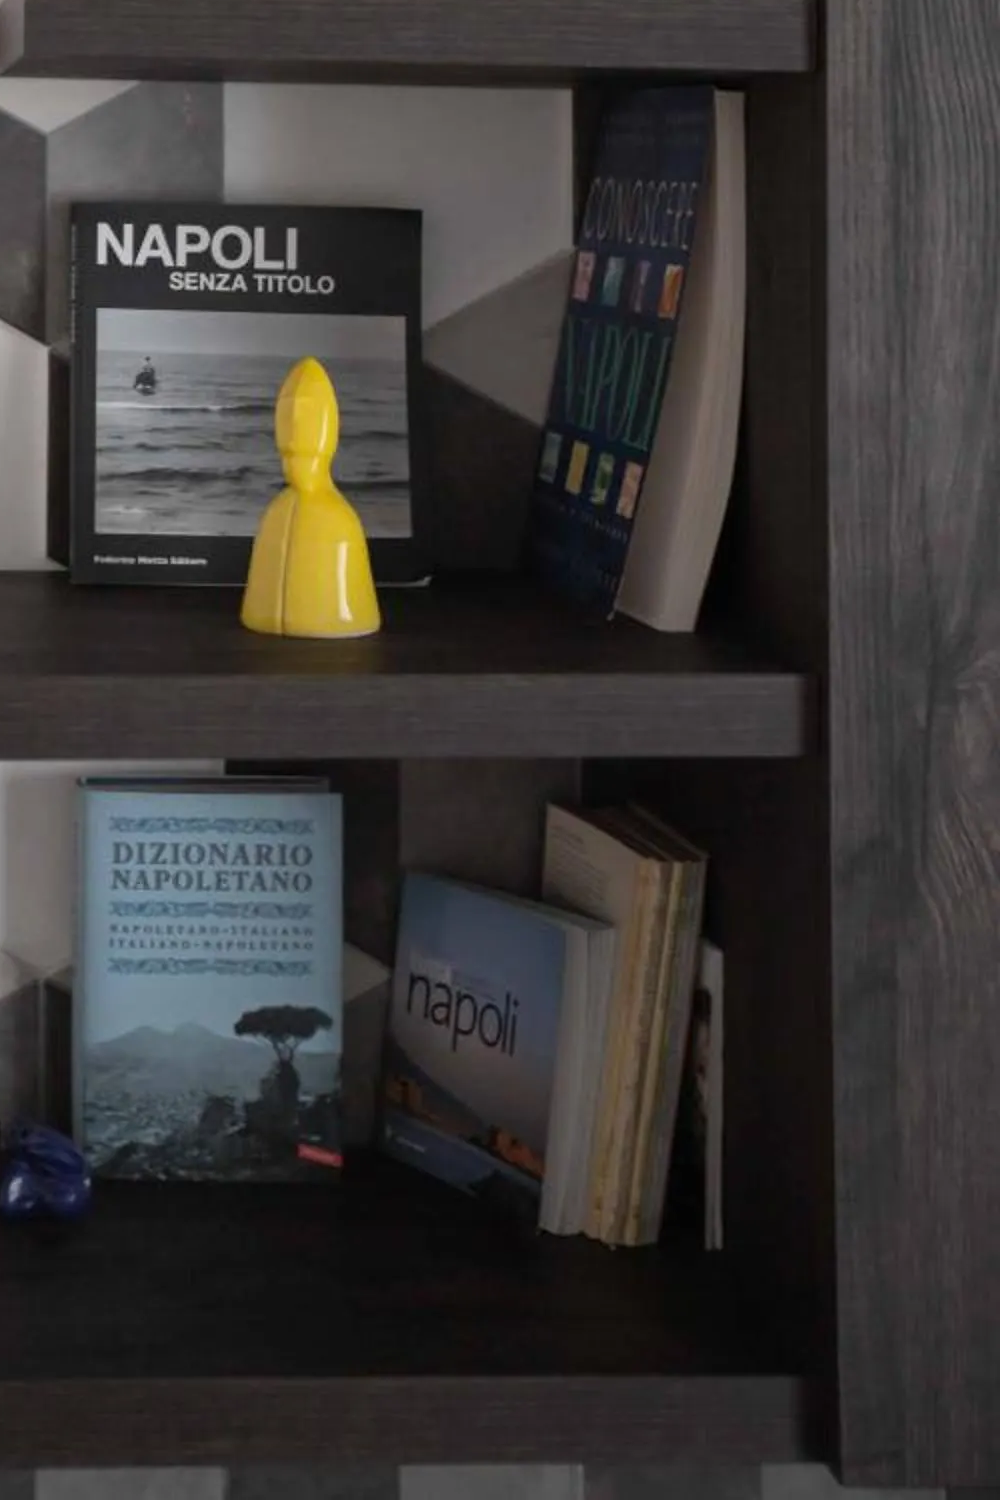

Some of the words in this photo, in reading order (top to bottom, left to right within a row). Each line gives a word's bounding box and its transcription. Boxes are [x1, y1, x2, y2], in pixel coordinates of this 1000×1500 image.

[96, 222, 298, 270] NAPOLI
[168, 271, 248, 292] SENZA
[253, 274, 335, 295] TITOLO
[111, 841, 314, 867] DIZIONARIO
[110, 868, 314, 894] NAPOLETANO
[406, 970, 520, 1057] napoli
